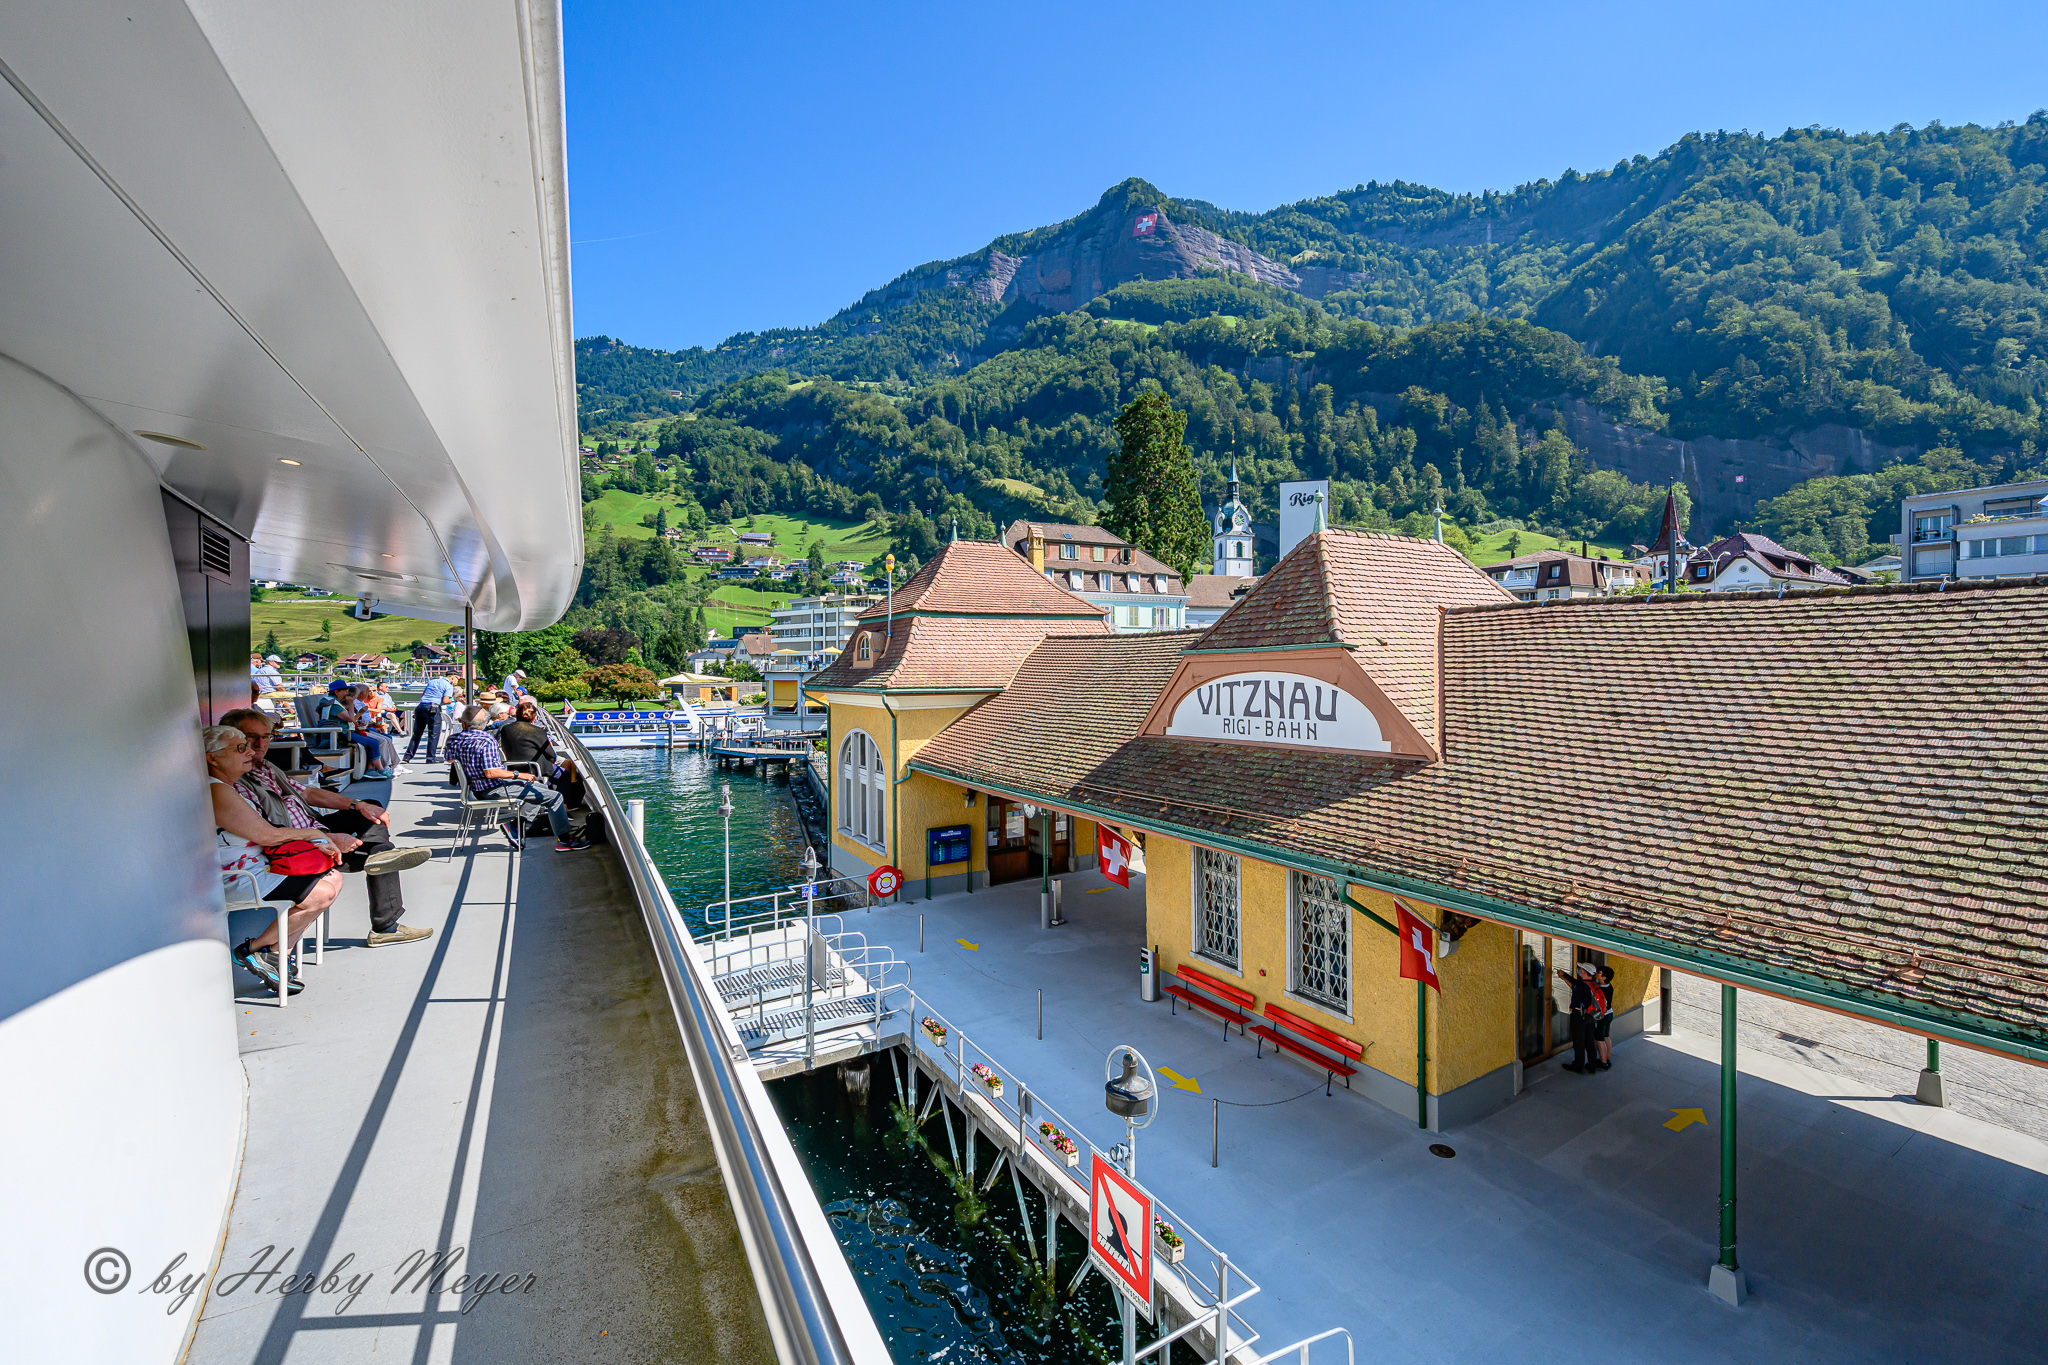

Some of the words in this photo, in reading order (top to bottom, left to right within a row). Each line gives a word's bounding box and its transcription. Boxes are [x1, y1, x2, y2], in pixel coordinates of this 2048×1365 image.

[1289, 489, 1319, 507] Rig
[1196, 679, 1339, 722] VITZNAU
[1222, 717, 1319, 741] RIGI-BAHN
